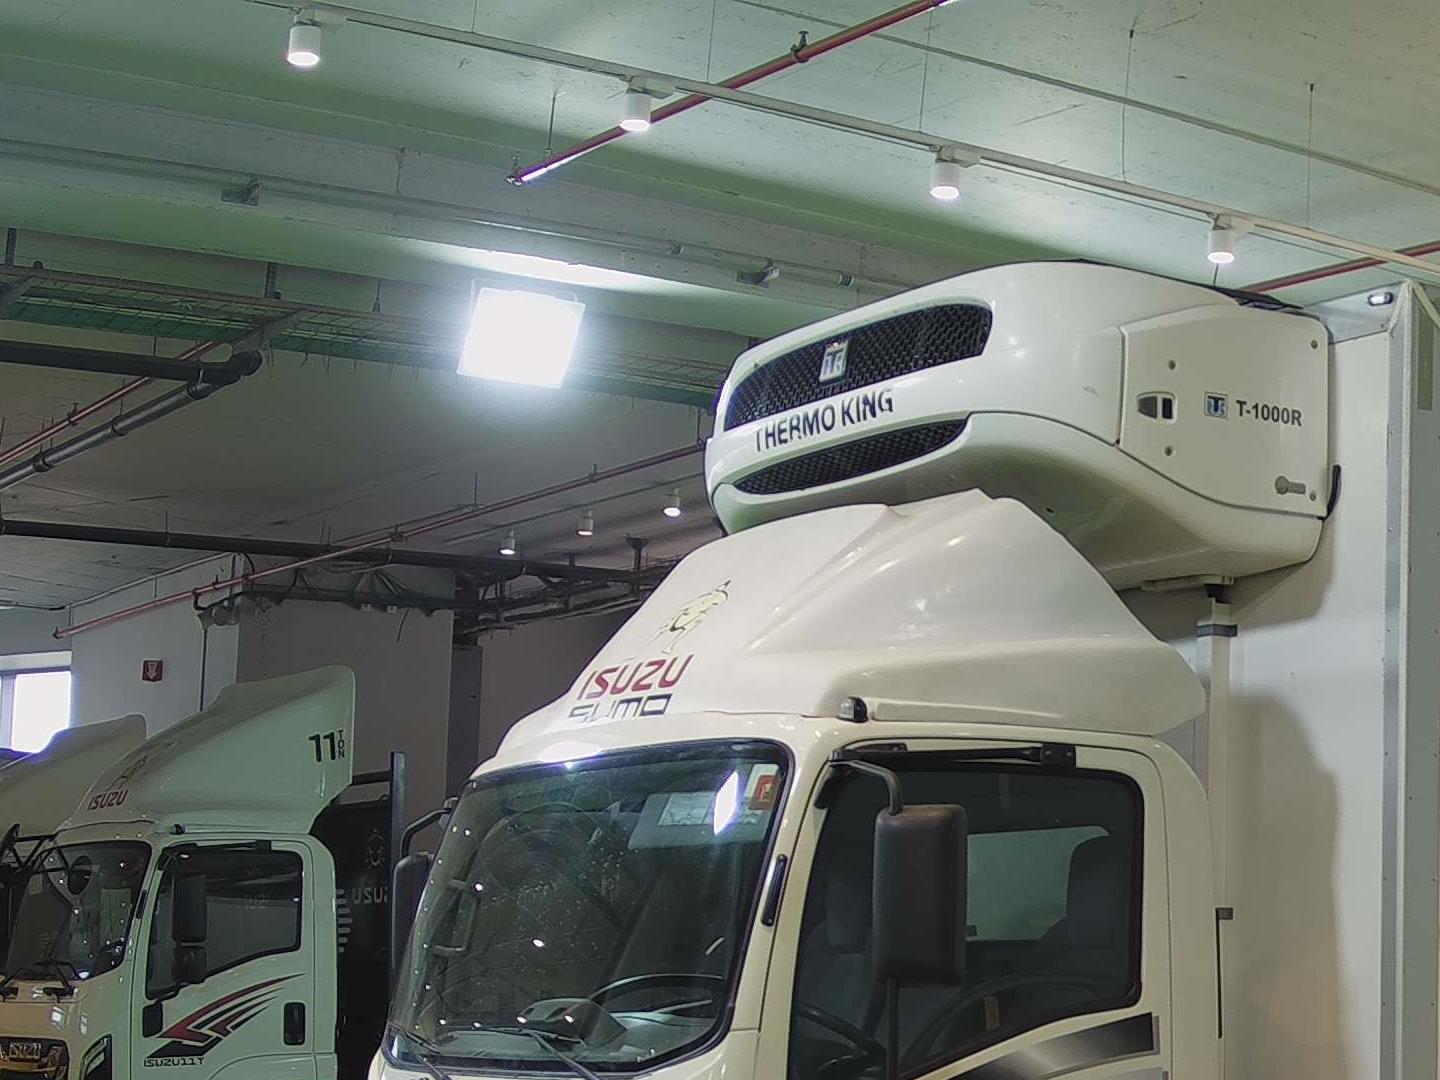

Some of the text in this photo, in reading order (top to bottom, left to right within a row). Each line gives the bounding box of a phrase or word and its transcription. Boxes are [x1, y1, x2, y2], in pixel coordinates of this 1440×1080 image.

[755, 388, 894, 451] THERMO KING
[1235, 399, 1303, 427] T-1000R
[577, 653, 695, 701] ISUZU
[308, 732, 337, 762] 11
[337, 729, 346, 760] TON
[87, 789, 128, 810] ISUZU
